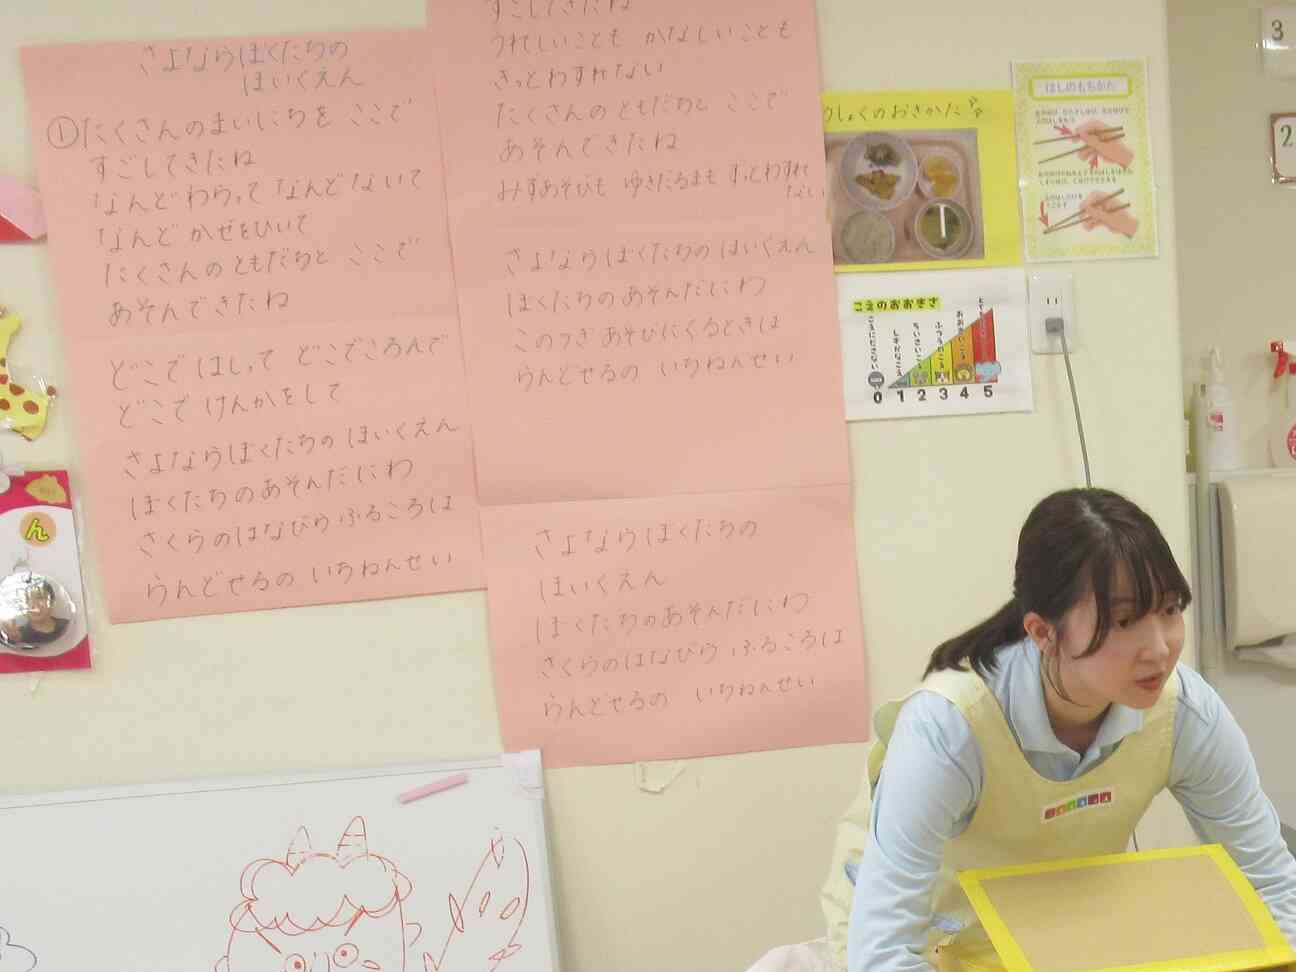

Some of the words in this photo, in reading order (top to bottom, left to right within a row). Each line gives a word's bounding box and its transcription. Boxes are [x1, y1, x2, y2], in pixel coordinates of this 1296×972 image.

[1271, 20, 1284, 41] 3
[1280, 125, 1293, 148] 2
[874, 391, 883, 404] 0
[897, 390, 905, 403] 1
[917, 389, 927, 401] 2
[939, 388, 949, 400] 3
[960, 386, 969, 399] 4
[983, 385, 993, 397] 5
